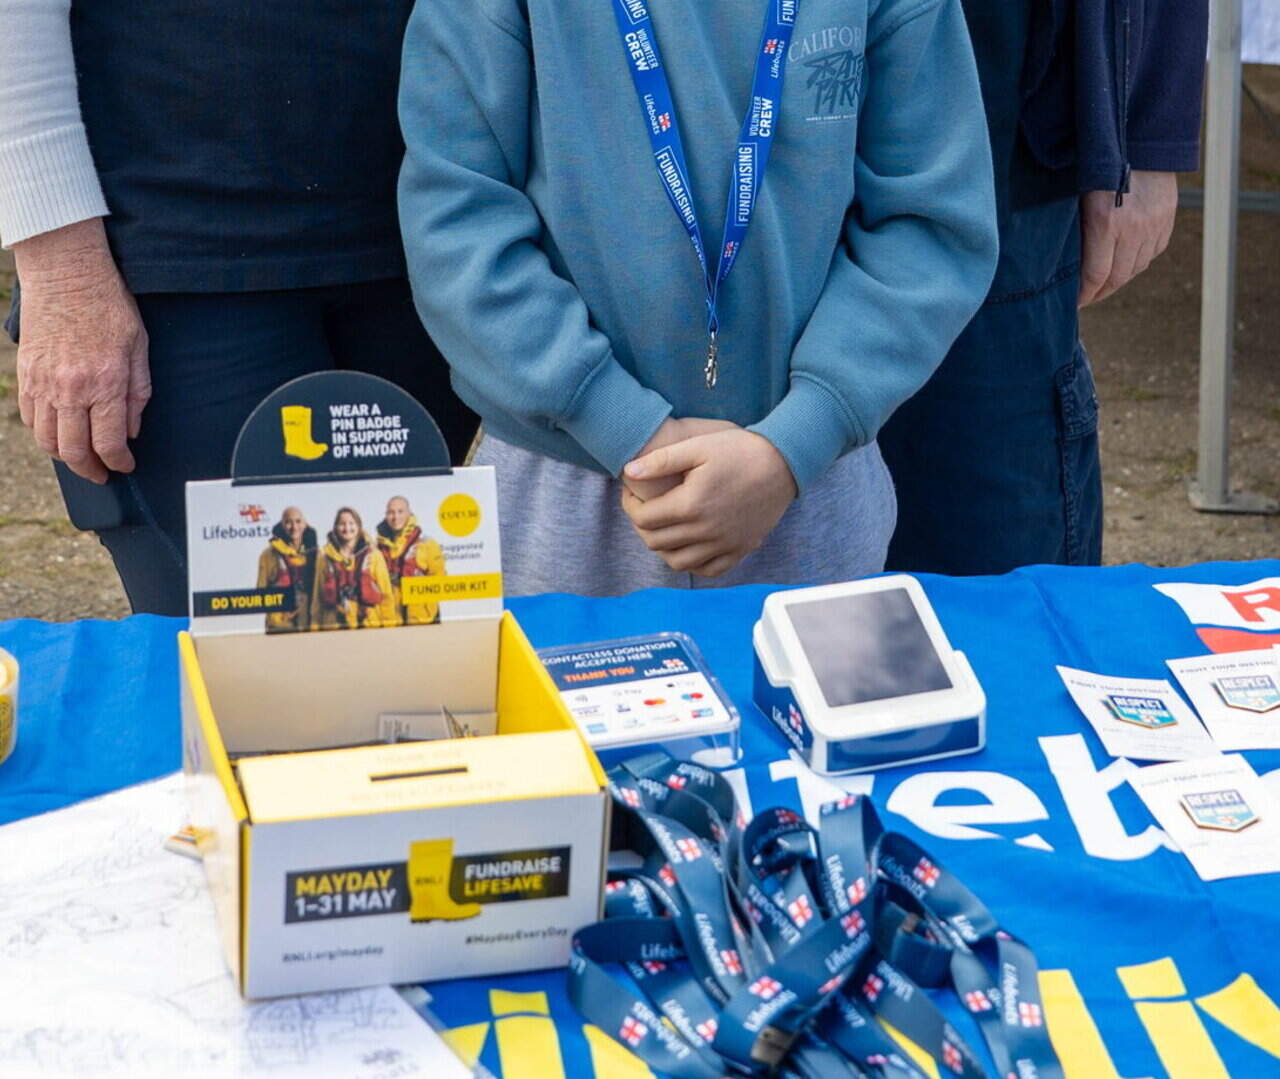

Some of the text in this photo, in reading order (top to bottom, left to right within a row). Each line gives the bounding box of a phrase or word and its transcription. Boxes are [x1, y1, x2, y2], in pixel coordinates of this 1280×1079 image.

[624, 32, 650, 72] CREW
[636, 28, 660, 70] VOLUNTEER
[771, 39, 786, 79] Lifeboats
[643, 93, 660, 136] Lifeboats
[749, 95, 762, 137] VOLUNTEER
[758, 97, 773, 138] CREW
[656, 151, 696, 226] FUNDRAISING
[738, 145, 753, 224] FUNDRAISING
[329, 402, 381, 418] WEAR A
[331, 415, 401, 431] PIN BADGE
[332, 428, 410, 444] IN SUPPORT
[333, 442, 406, 458] OF MAYDAY
[203, 524, 270, 541] Lifeboats
[410, 580, 488, 595] FUND OUR KIT
[211, 593, 284, 610] DO YOUR BIT
[542, 640, 677, 666] CONTACTLESS DONATIONS
[574, 651, 653, 670] ACCEPTED HERE
[563, 666, 635, 683] THANK YOU
[464, 856, 562, 881] FUNDRAISE
[295, 869, 393, 896] MAYDAY
[416, 876, 443, 886] RNLI
[463, 874, 544, 897] LIFESAVE
[348, 887, 397, 912] MAY
[464, 926, 568, 946] #MaydayEveryDay
[282, 945, 383, 964] RNLI.org/mayday
